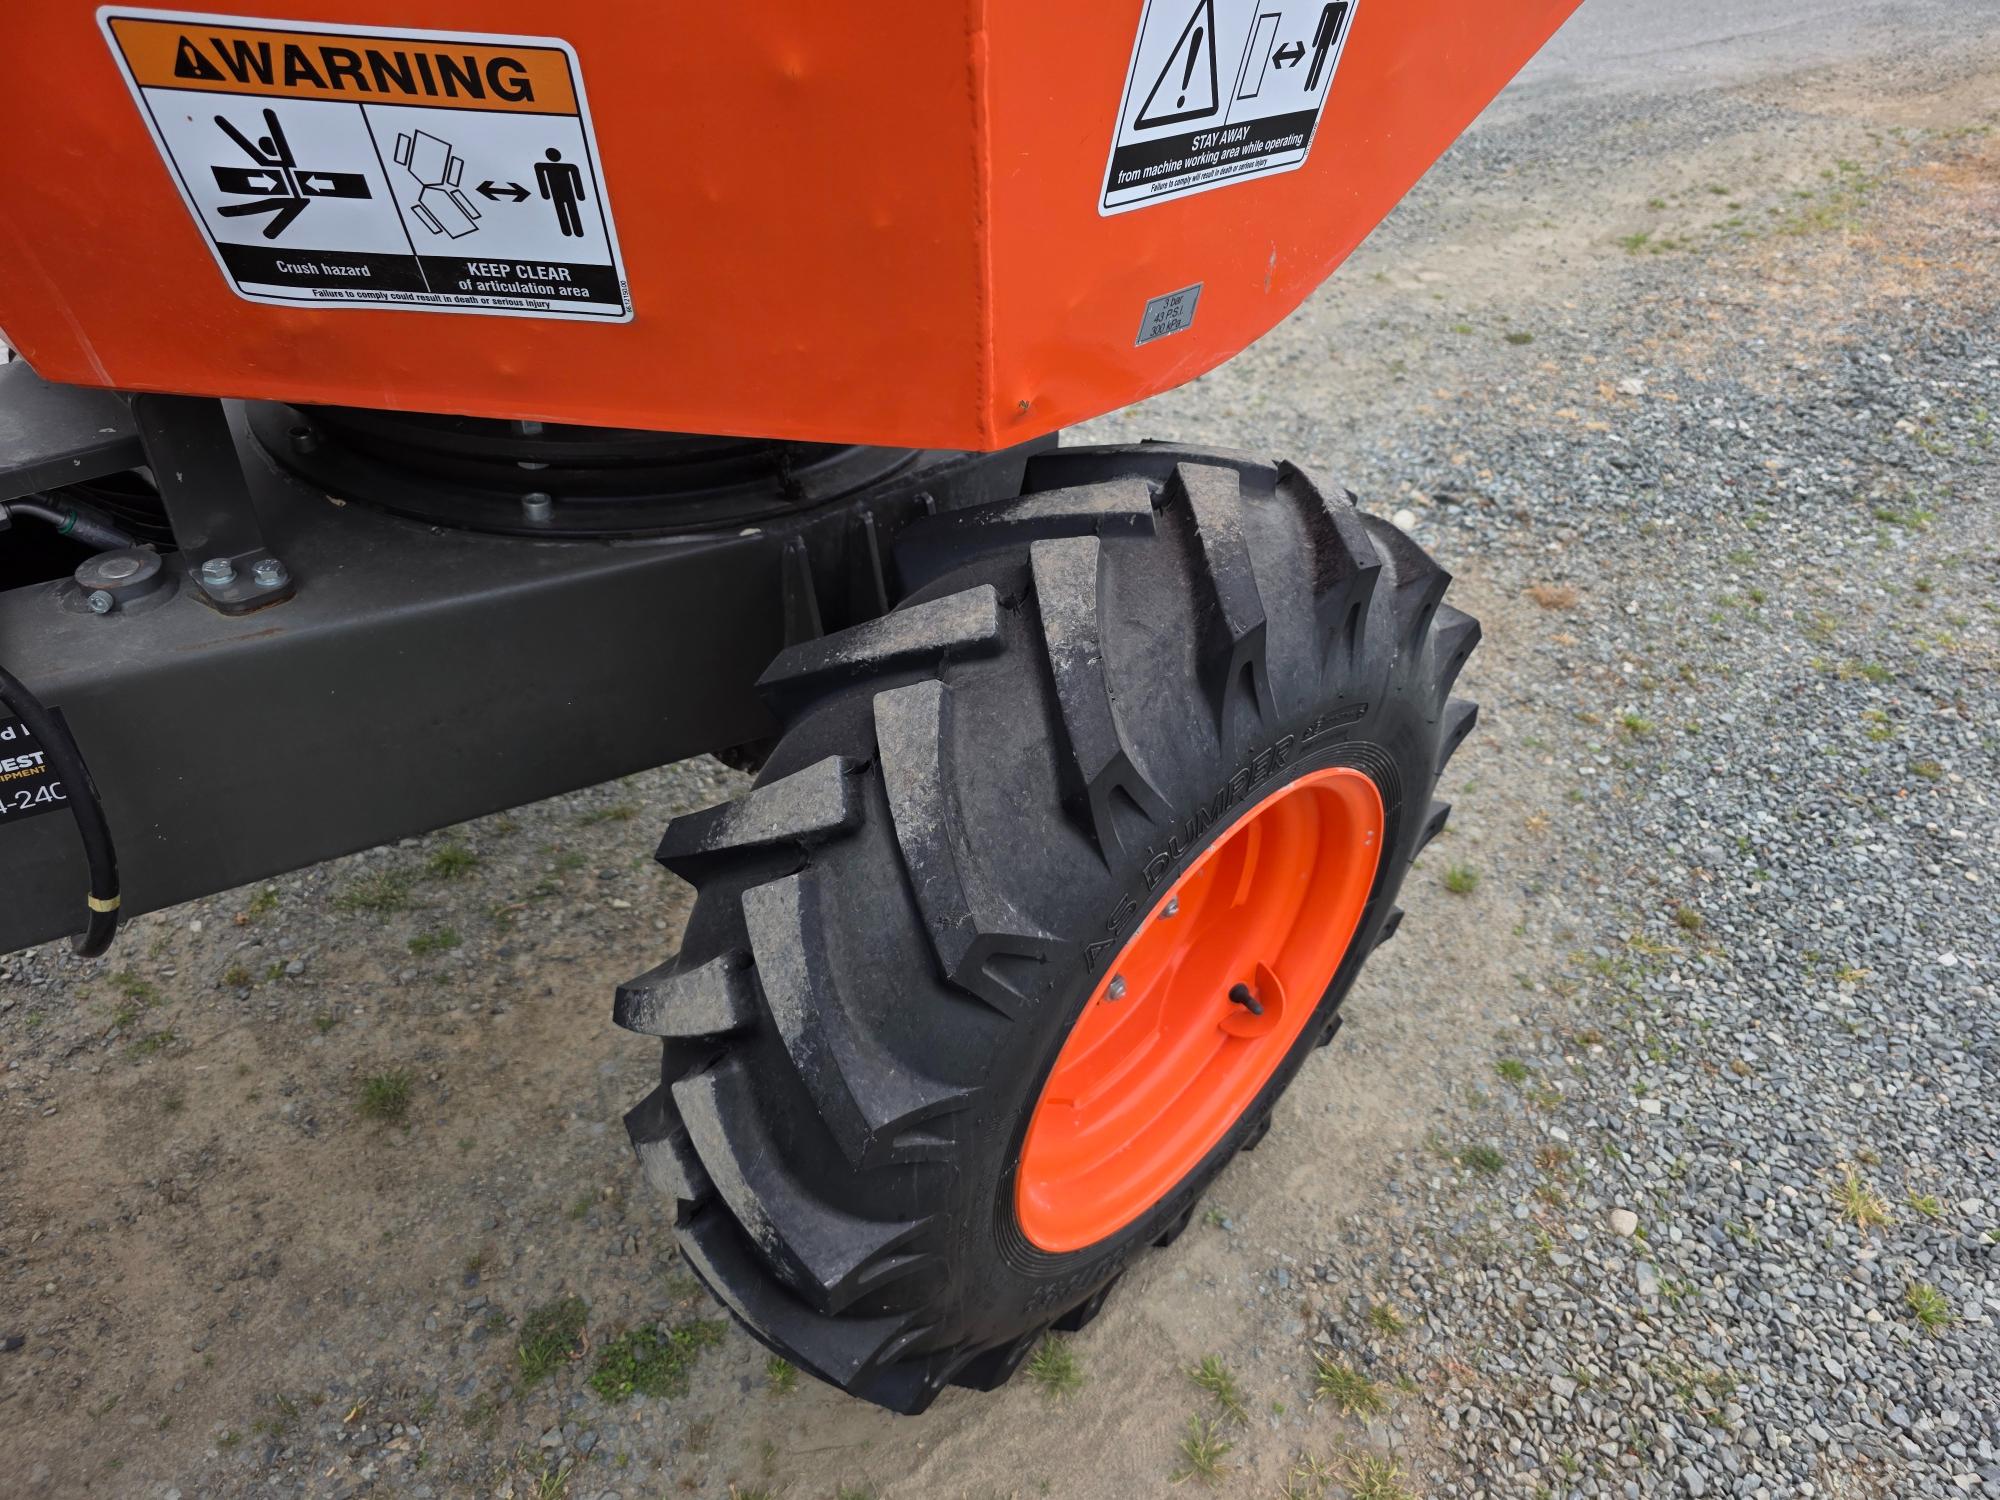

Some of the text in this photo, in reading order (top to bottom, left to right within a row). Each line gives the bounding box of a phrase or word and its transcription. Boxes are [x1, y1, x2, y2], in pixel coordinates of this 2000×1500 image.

[210, 38, 535, 102] WARNING
[1191, 126, 1251, 151] STAY AWAY
[1117, 168, 1141, 184] from
[1143, 158, 1182, 178] machine
[1184, 150, 1220, 165] working
[1220, 146, 1240, 160] area
[1242, 140, 1264, 154] while
[1264, 133, 1303, 150] operating
[1150, 182, 1168, 192] Failure
[1174, 175, 1191, 186] comply
[1191, 173, 1201, 181] will
[1200, 170, 1215, 180] result
[1220, 165, 1233, 175] death
[1238, 161, 1254, 171] serious
[275, 260, 371, 277] Crush hazard
[467, 262, 572, 281] KEEP CLEAR
[458, 280, 590, 297] of articulation area
[312, 289, 343, 298] Failure
[356, 291, 388, 301] comply
[390, 292, 415, 301] could
[417, 294, 441, 302] result
[443, 295, 451, 303] in
[454, 295, 479, 304] death
[492, 297, 524, 306] serious
[526, 299, 550, 309] injury
[1163, 296, 1184, 309] 3 bar
[1154, 311, 1165, 323] 43
[1150, 323, 1166, 337] 300
[0, 751, 44, 773] EST
[0, 765, 46, 782] IPMENT
